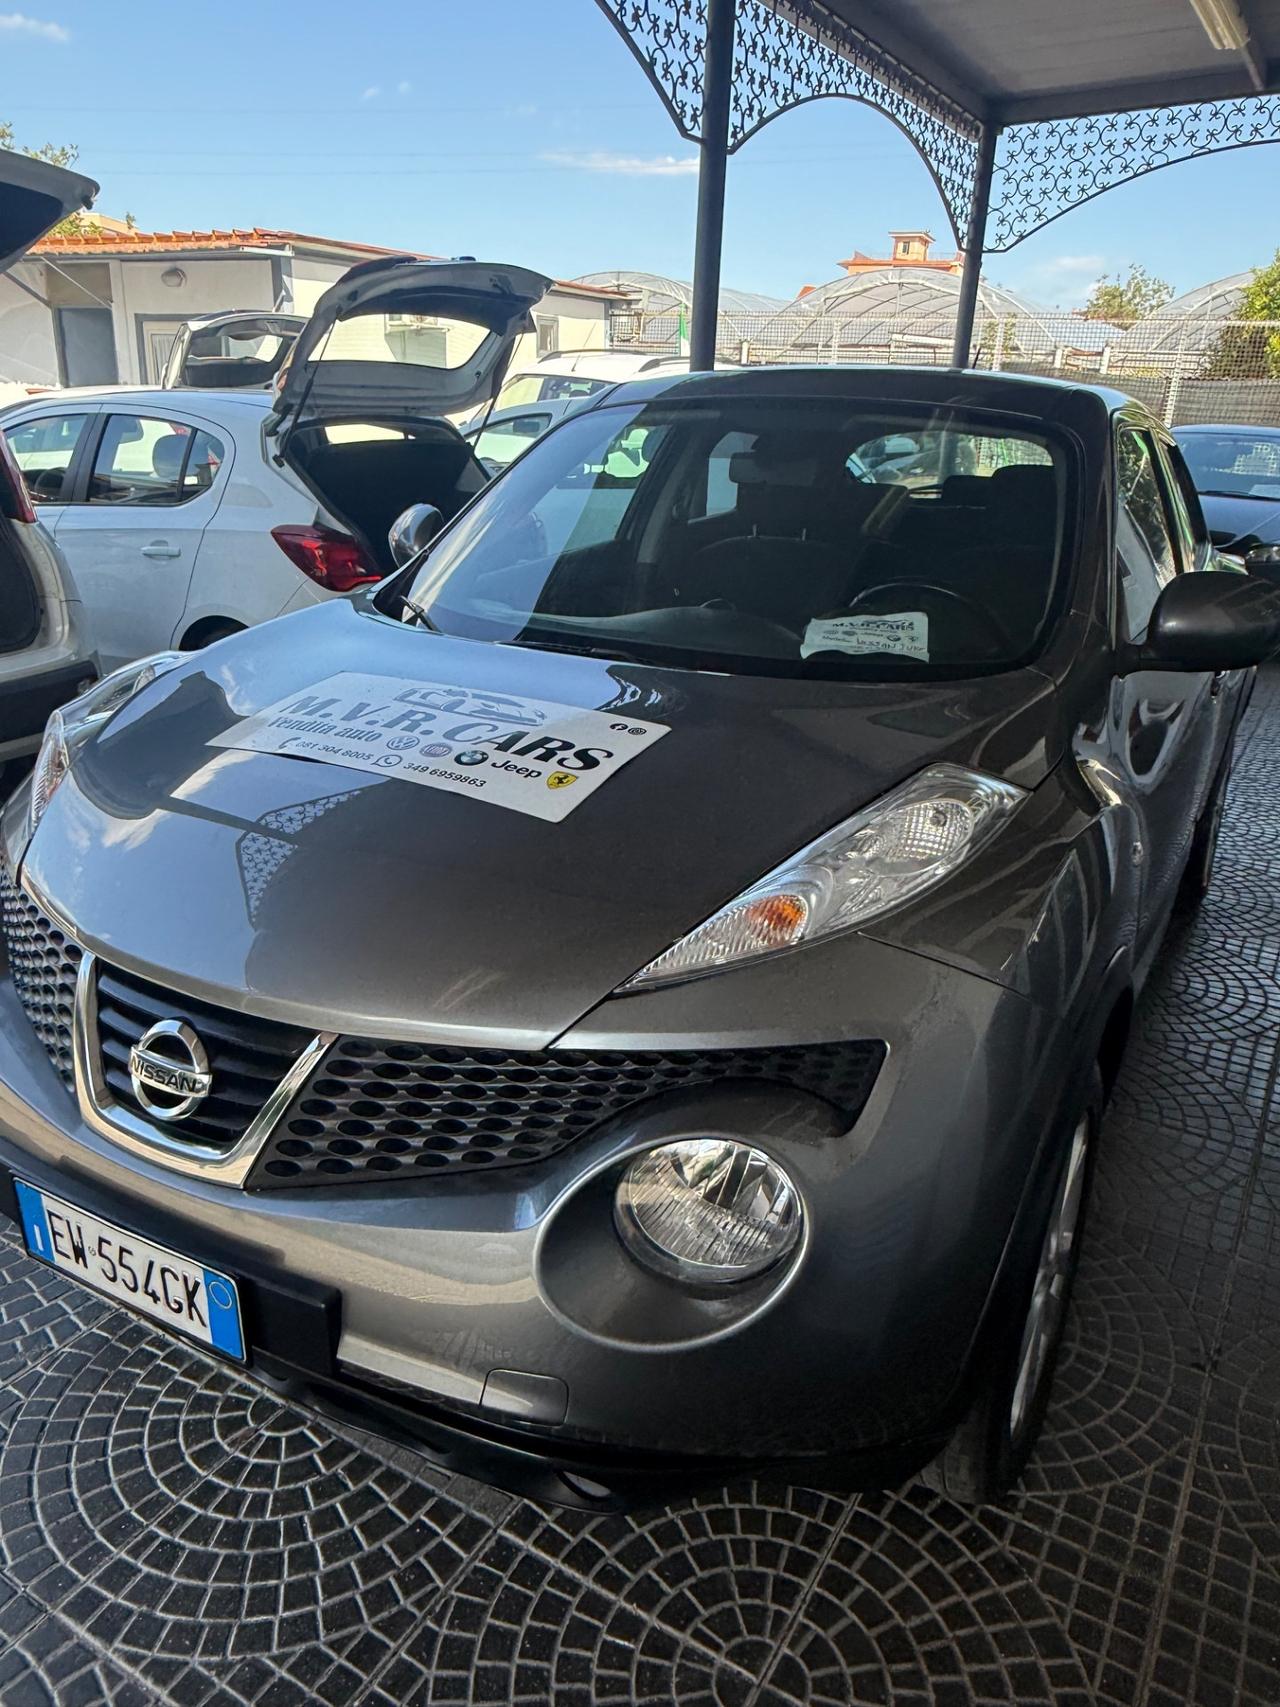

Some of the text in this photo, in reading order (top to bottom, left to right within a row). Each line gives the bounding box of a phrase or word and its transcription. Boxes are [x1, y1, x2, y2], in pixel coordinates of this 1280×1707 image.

[268, 716, 383, 742] Vendita auto
[318, 744, 343, 754] 304
[341, 750, 374, 761] 8005
[403, 762, 487, 788] 349 6959863
[491, 760, 543, 779] Jeep
[131, 1055, 197, 1094] NISSAN
